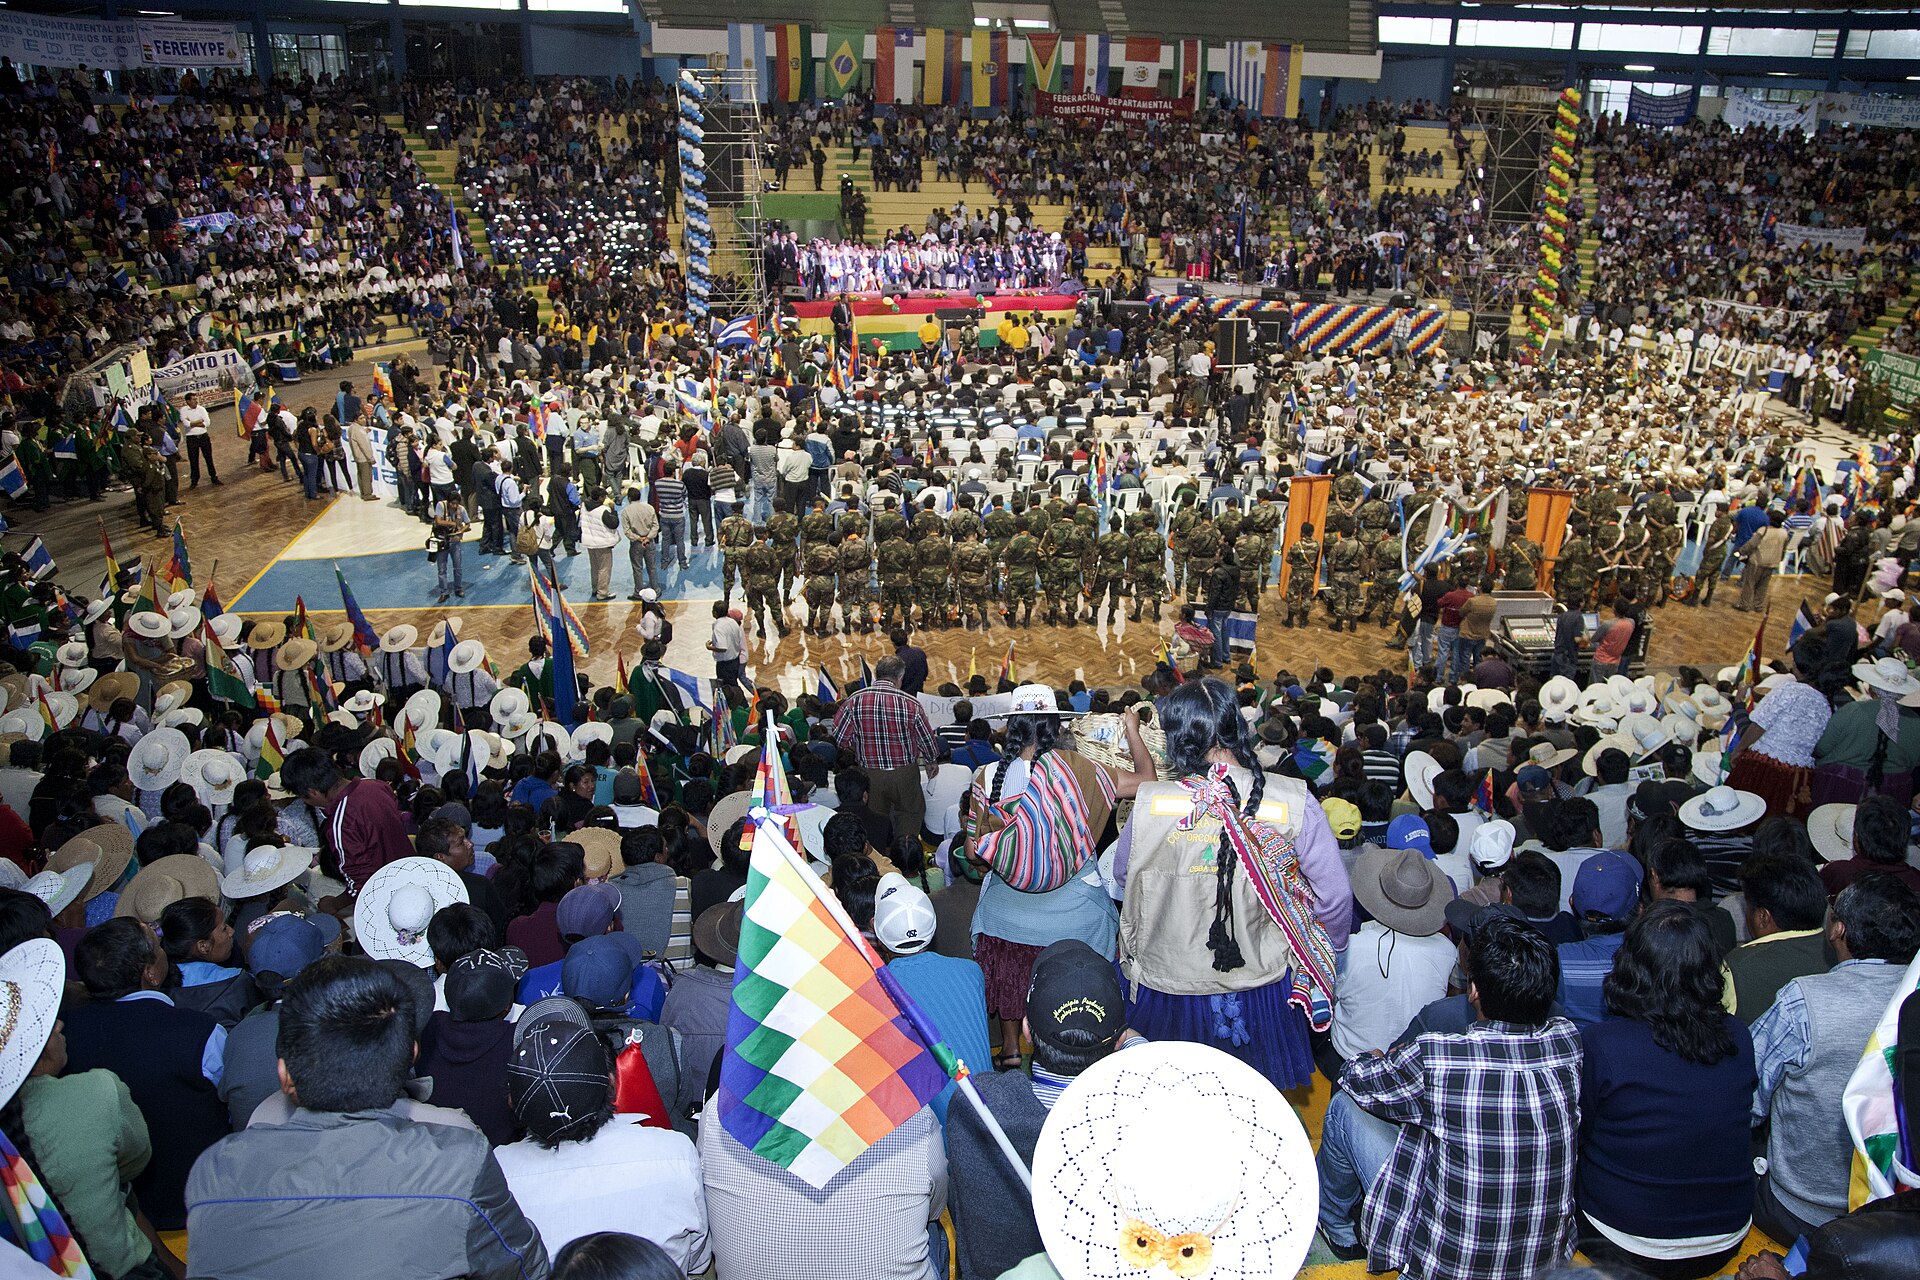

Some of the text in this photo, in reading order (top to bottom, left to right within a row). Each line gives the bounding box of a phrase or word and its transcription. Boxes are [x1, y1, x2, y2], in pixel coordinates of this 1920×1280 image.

[31, 19, 114, 33] DEPARTAMENTAL
[115, 24, 126, 33] DE
[26, 28, 100, 43] COMUNITARIOS
[102, 34, 114, 43] DE
[117, 34, 135, 44] AGUA
[153, 40, 225, 56] FEREMYPE
[1108, 97, 1173, 109] DEPARTAMENTAL
[1850, 103, 1903, 114] ELEUTERIO
[1852, 97, 1896, 106] CENTRAL
[1053, 105, 1171, 121] COMERCIANTES MINORITAS
[153, 352, 238, 378] DISTRITO 11
[930, 700, 996, 717] DIGDAD
